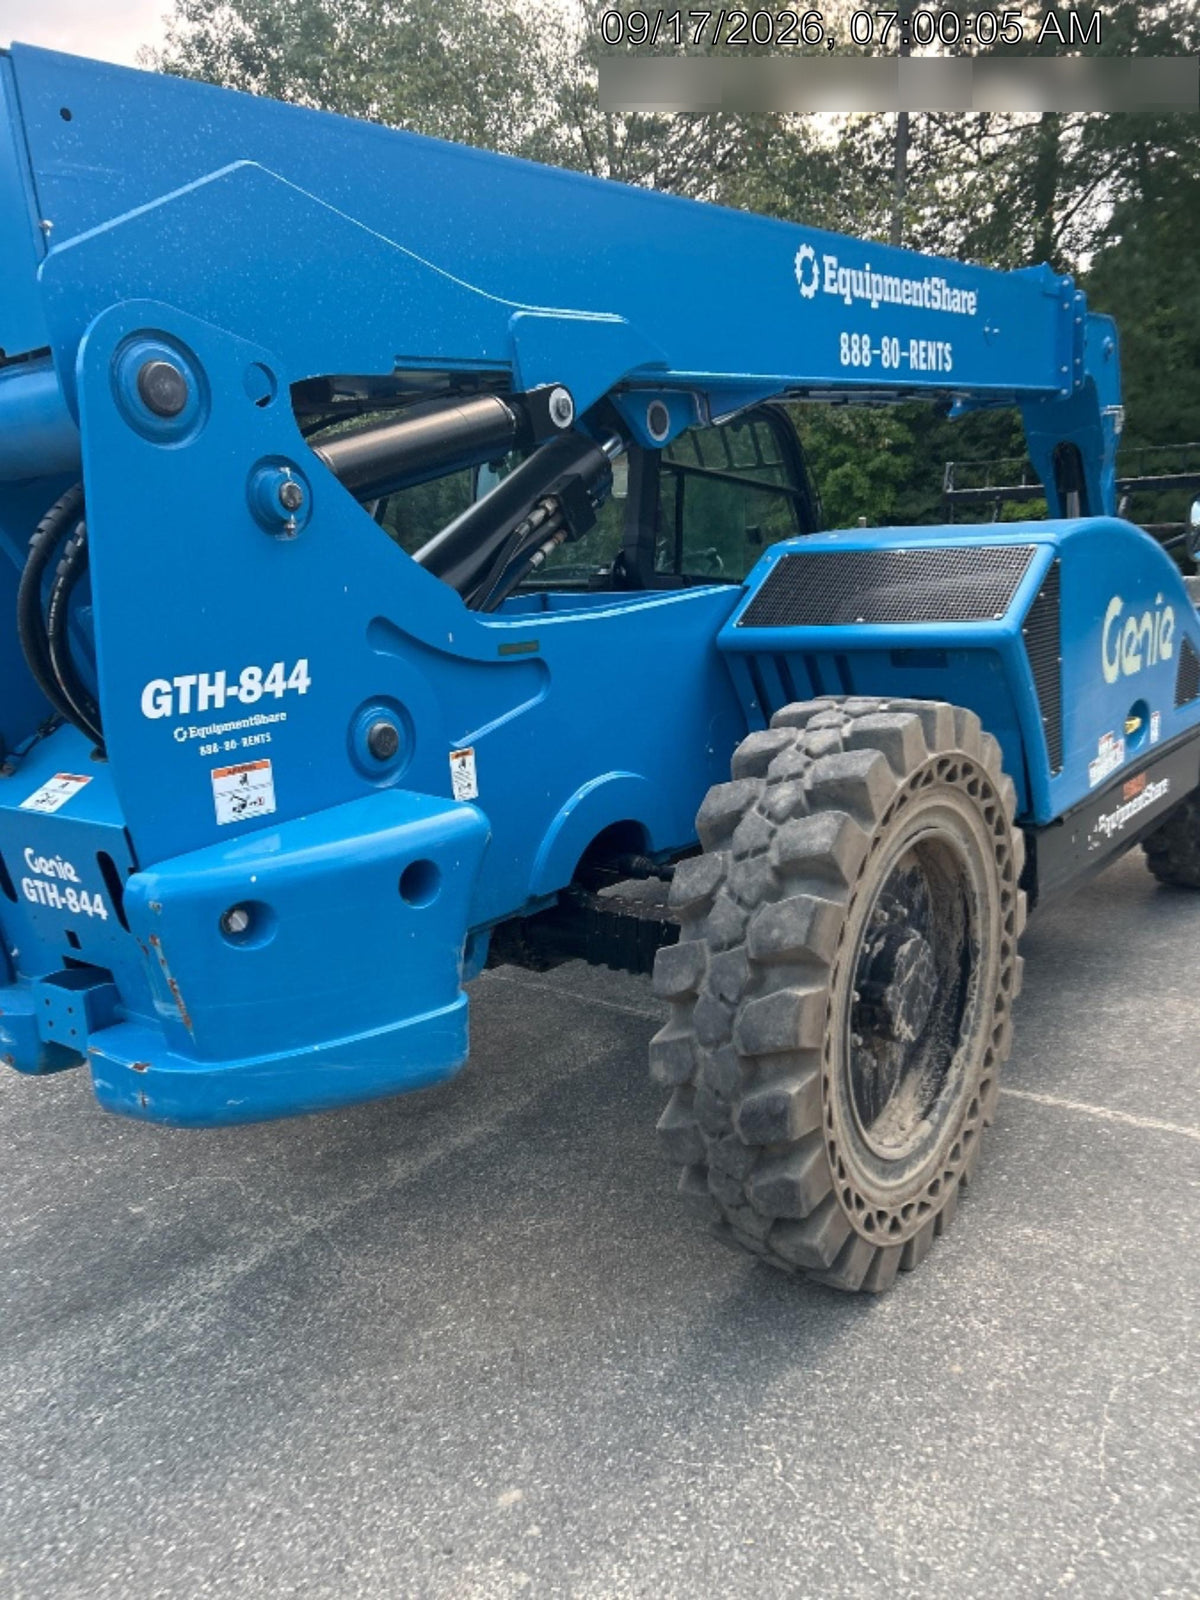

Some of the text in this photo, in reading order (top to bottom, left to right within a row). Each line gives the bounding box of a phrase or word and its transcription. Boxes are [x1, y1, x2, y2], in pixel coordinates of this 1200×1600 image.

[823, 255, 977, 316] EquipmentShare
[840, 332, 953, 372] 888-80-RENTS
[1102, 592, 1175, 684] Genie
[141, 658, 311, 719] GTH-844
[188, 712, 287, 739] EquipmentShare
[24, 847, 82, 883] Genie
[22, 877, 108, 920] GTH-844
